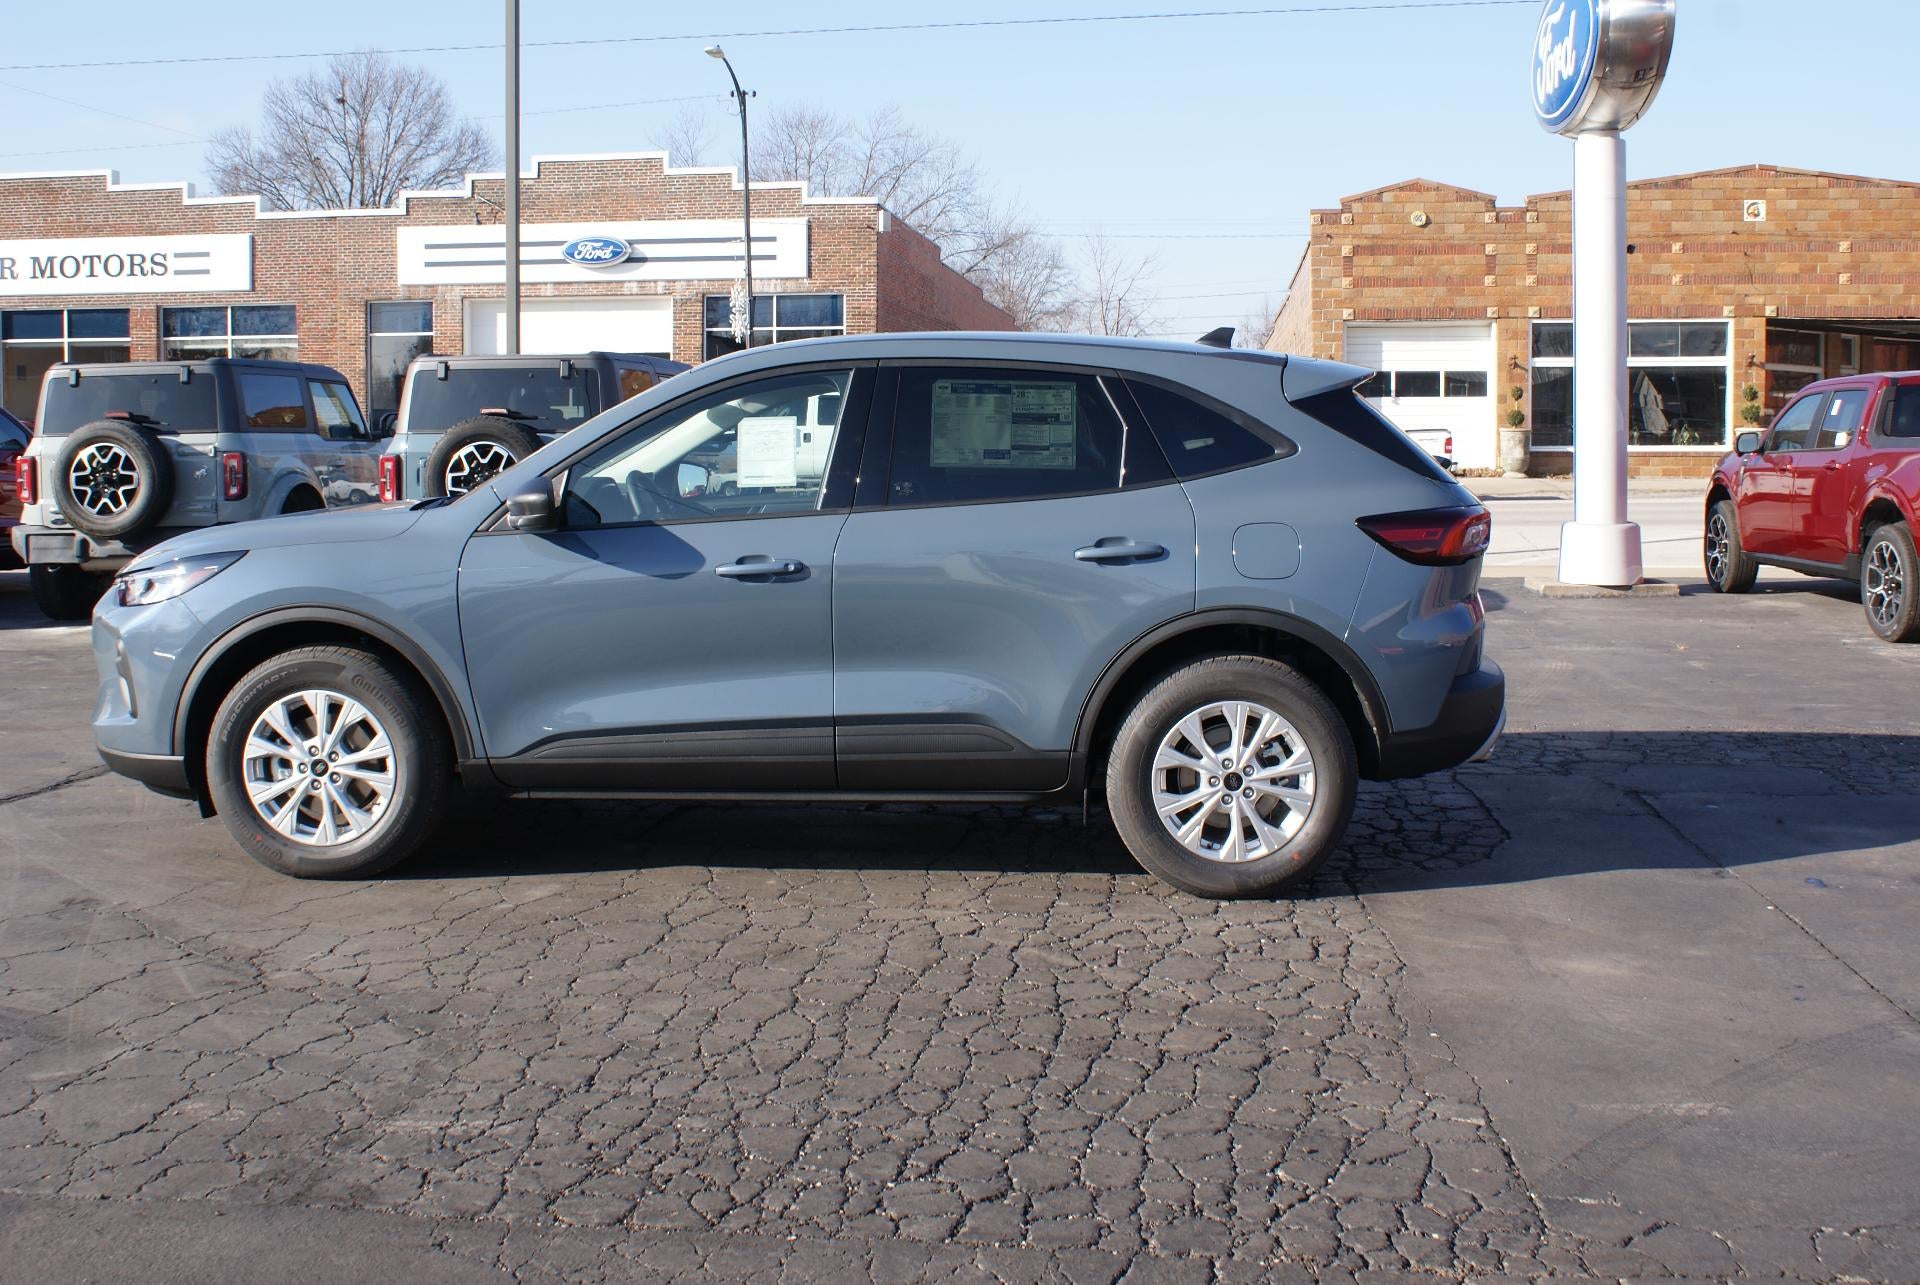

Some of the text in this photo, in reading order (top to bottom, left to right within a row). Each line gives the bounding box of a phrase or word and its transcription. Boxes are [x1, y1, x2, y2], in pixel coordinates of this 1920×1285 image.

[1536, 1, 1576, 104] Ford
[29, 252, 168, 279] MOTORS
[574, 241, 614, 259] Ford
[352, 674, 408, 729] Continental
